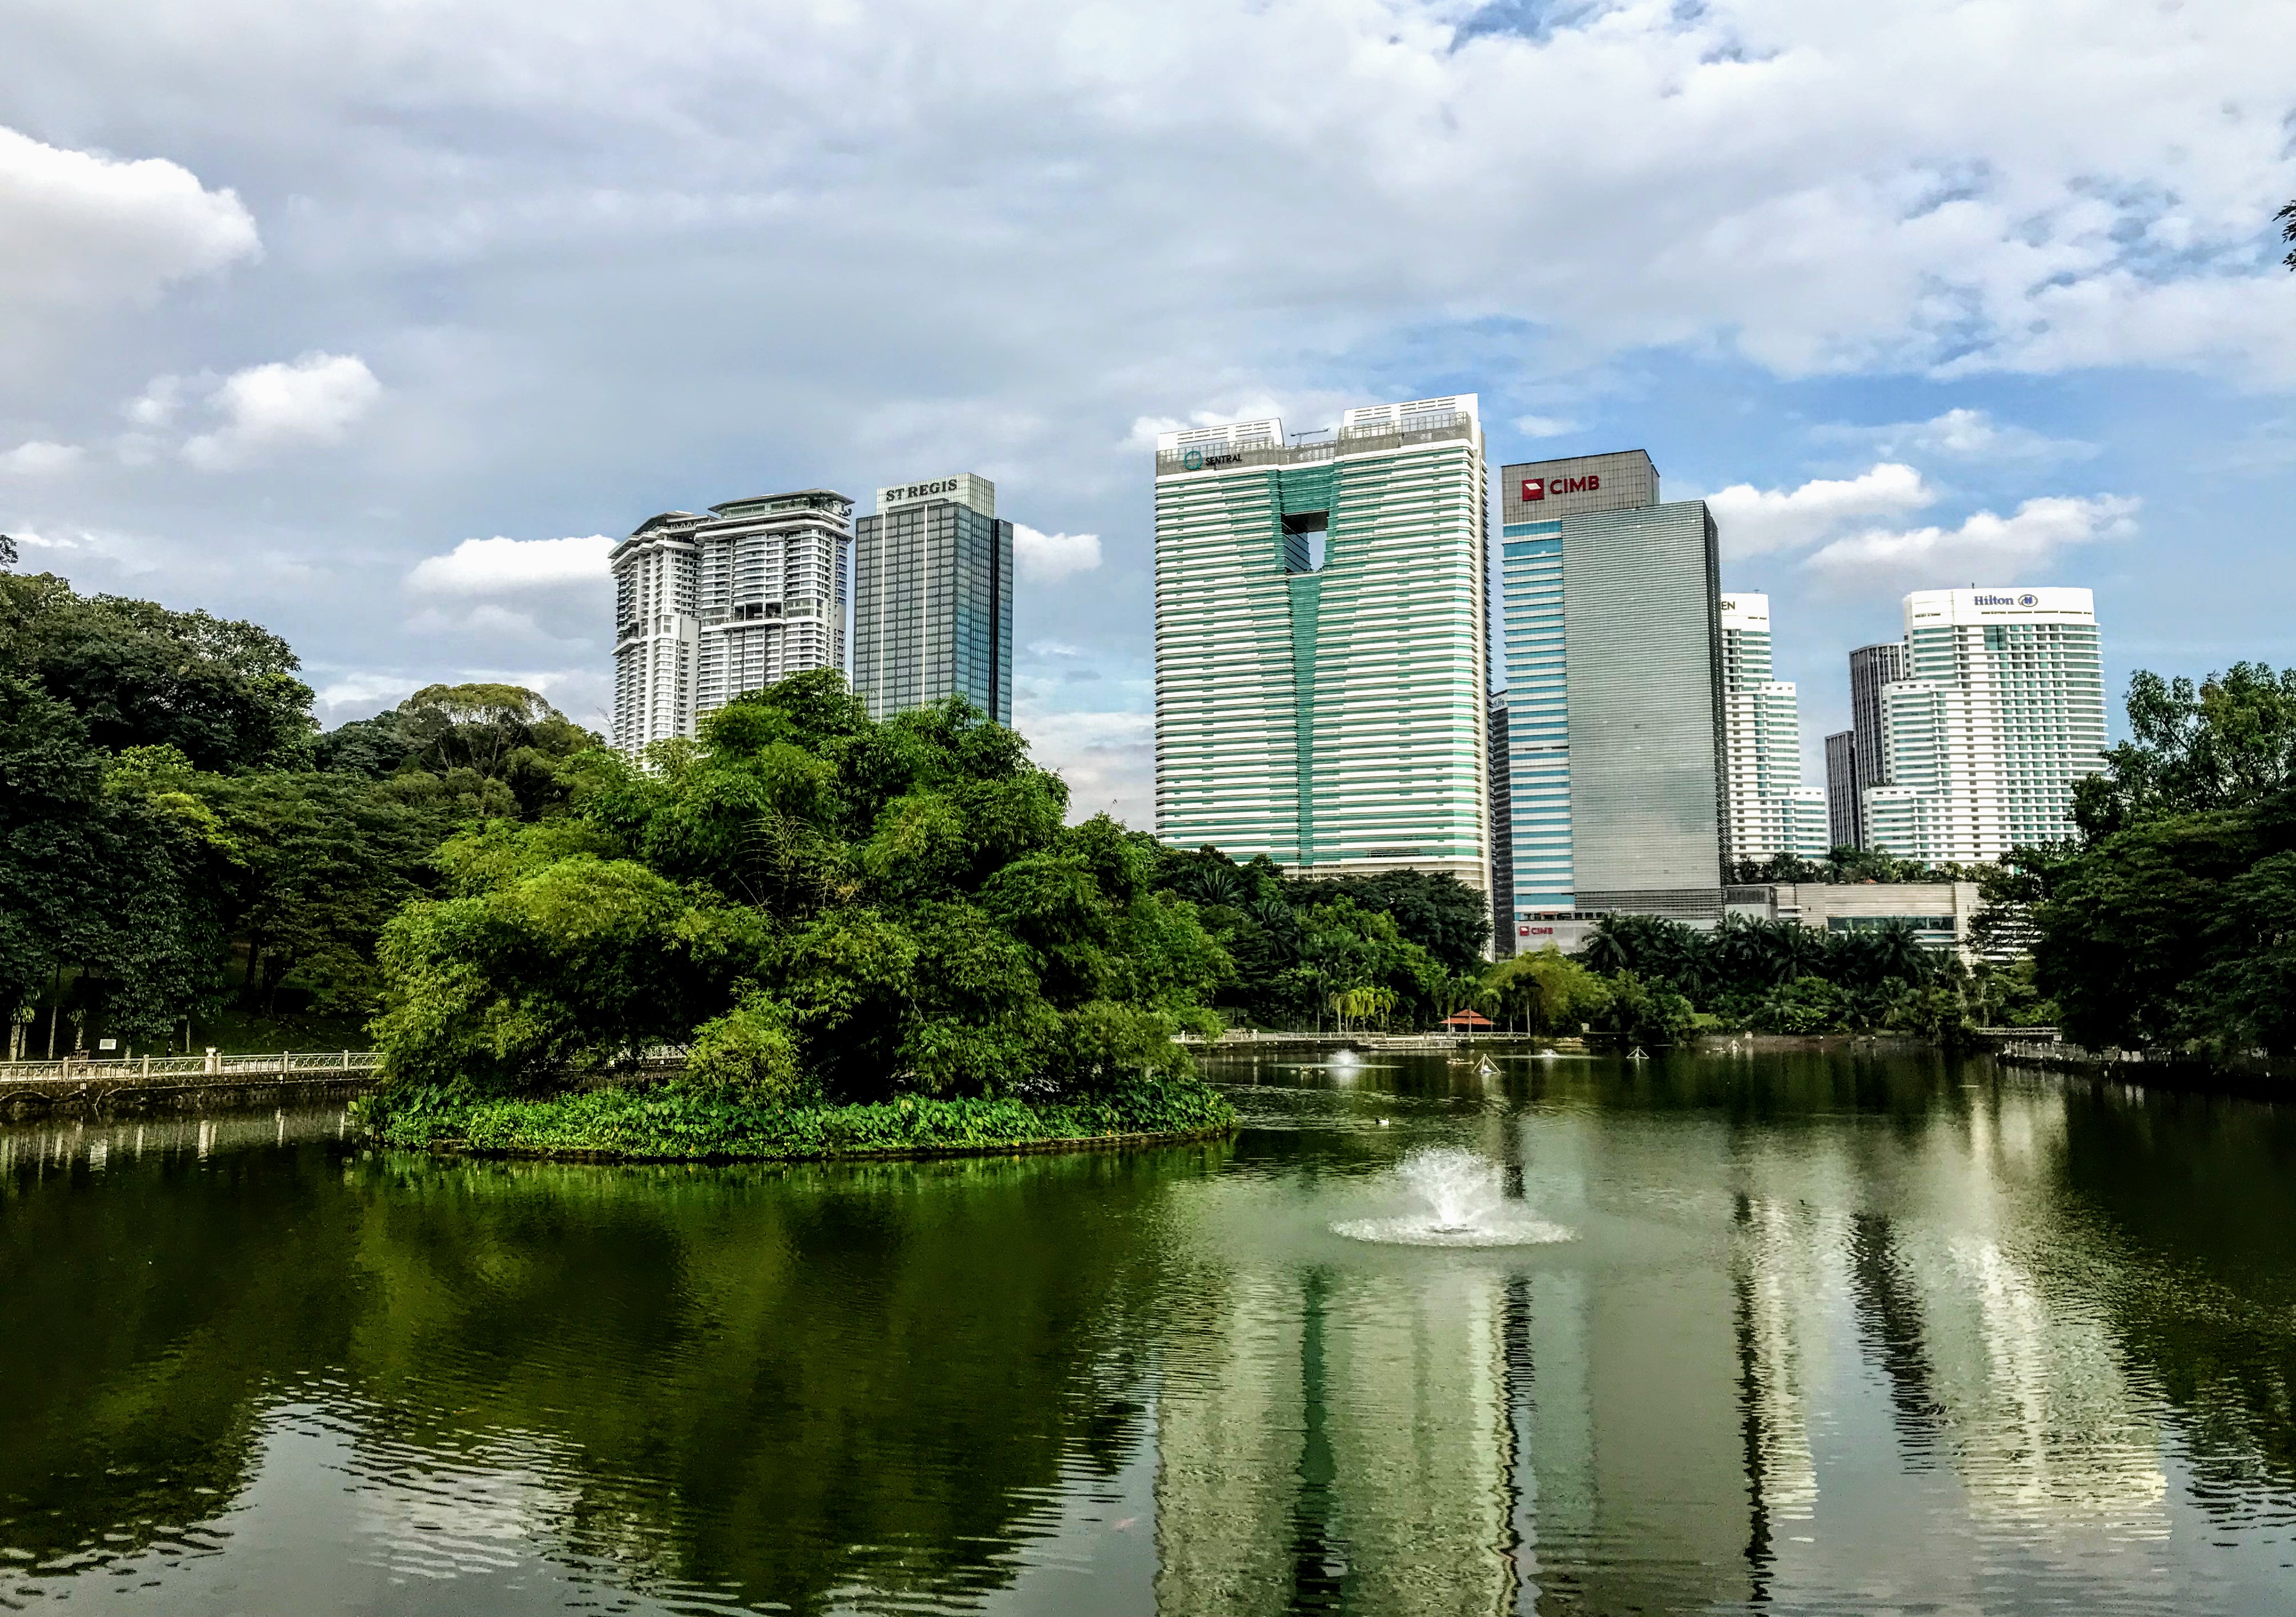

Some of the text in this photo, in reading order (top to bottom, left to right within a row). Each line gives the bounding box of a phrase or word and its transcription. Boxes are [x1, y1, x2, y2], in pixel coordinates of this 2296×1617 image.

[1206, 454, 1242, 466] SENTRAL
[886, 479, 957, 501] ST REGIS
[1550, 475, 1600, 495] CIMB
[1974, 595, 2014, 605] Hilton
